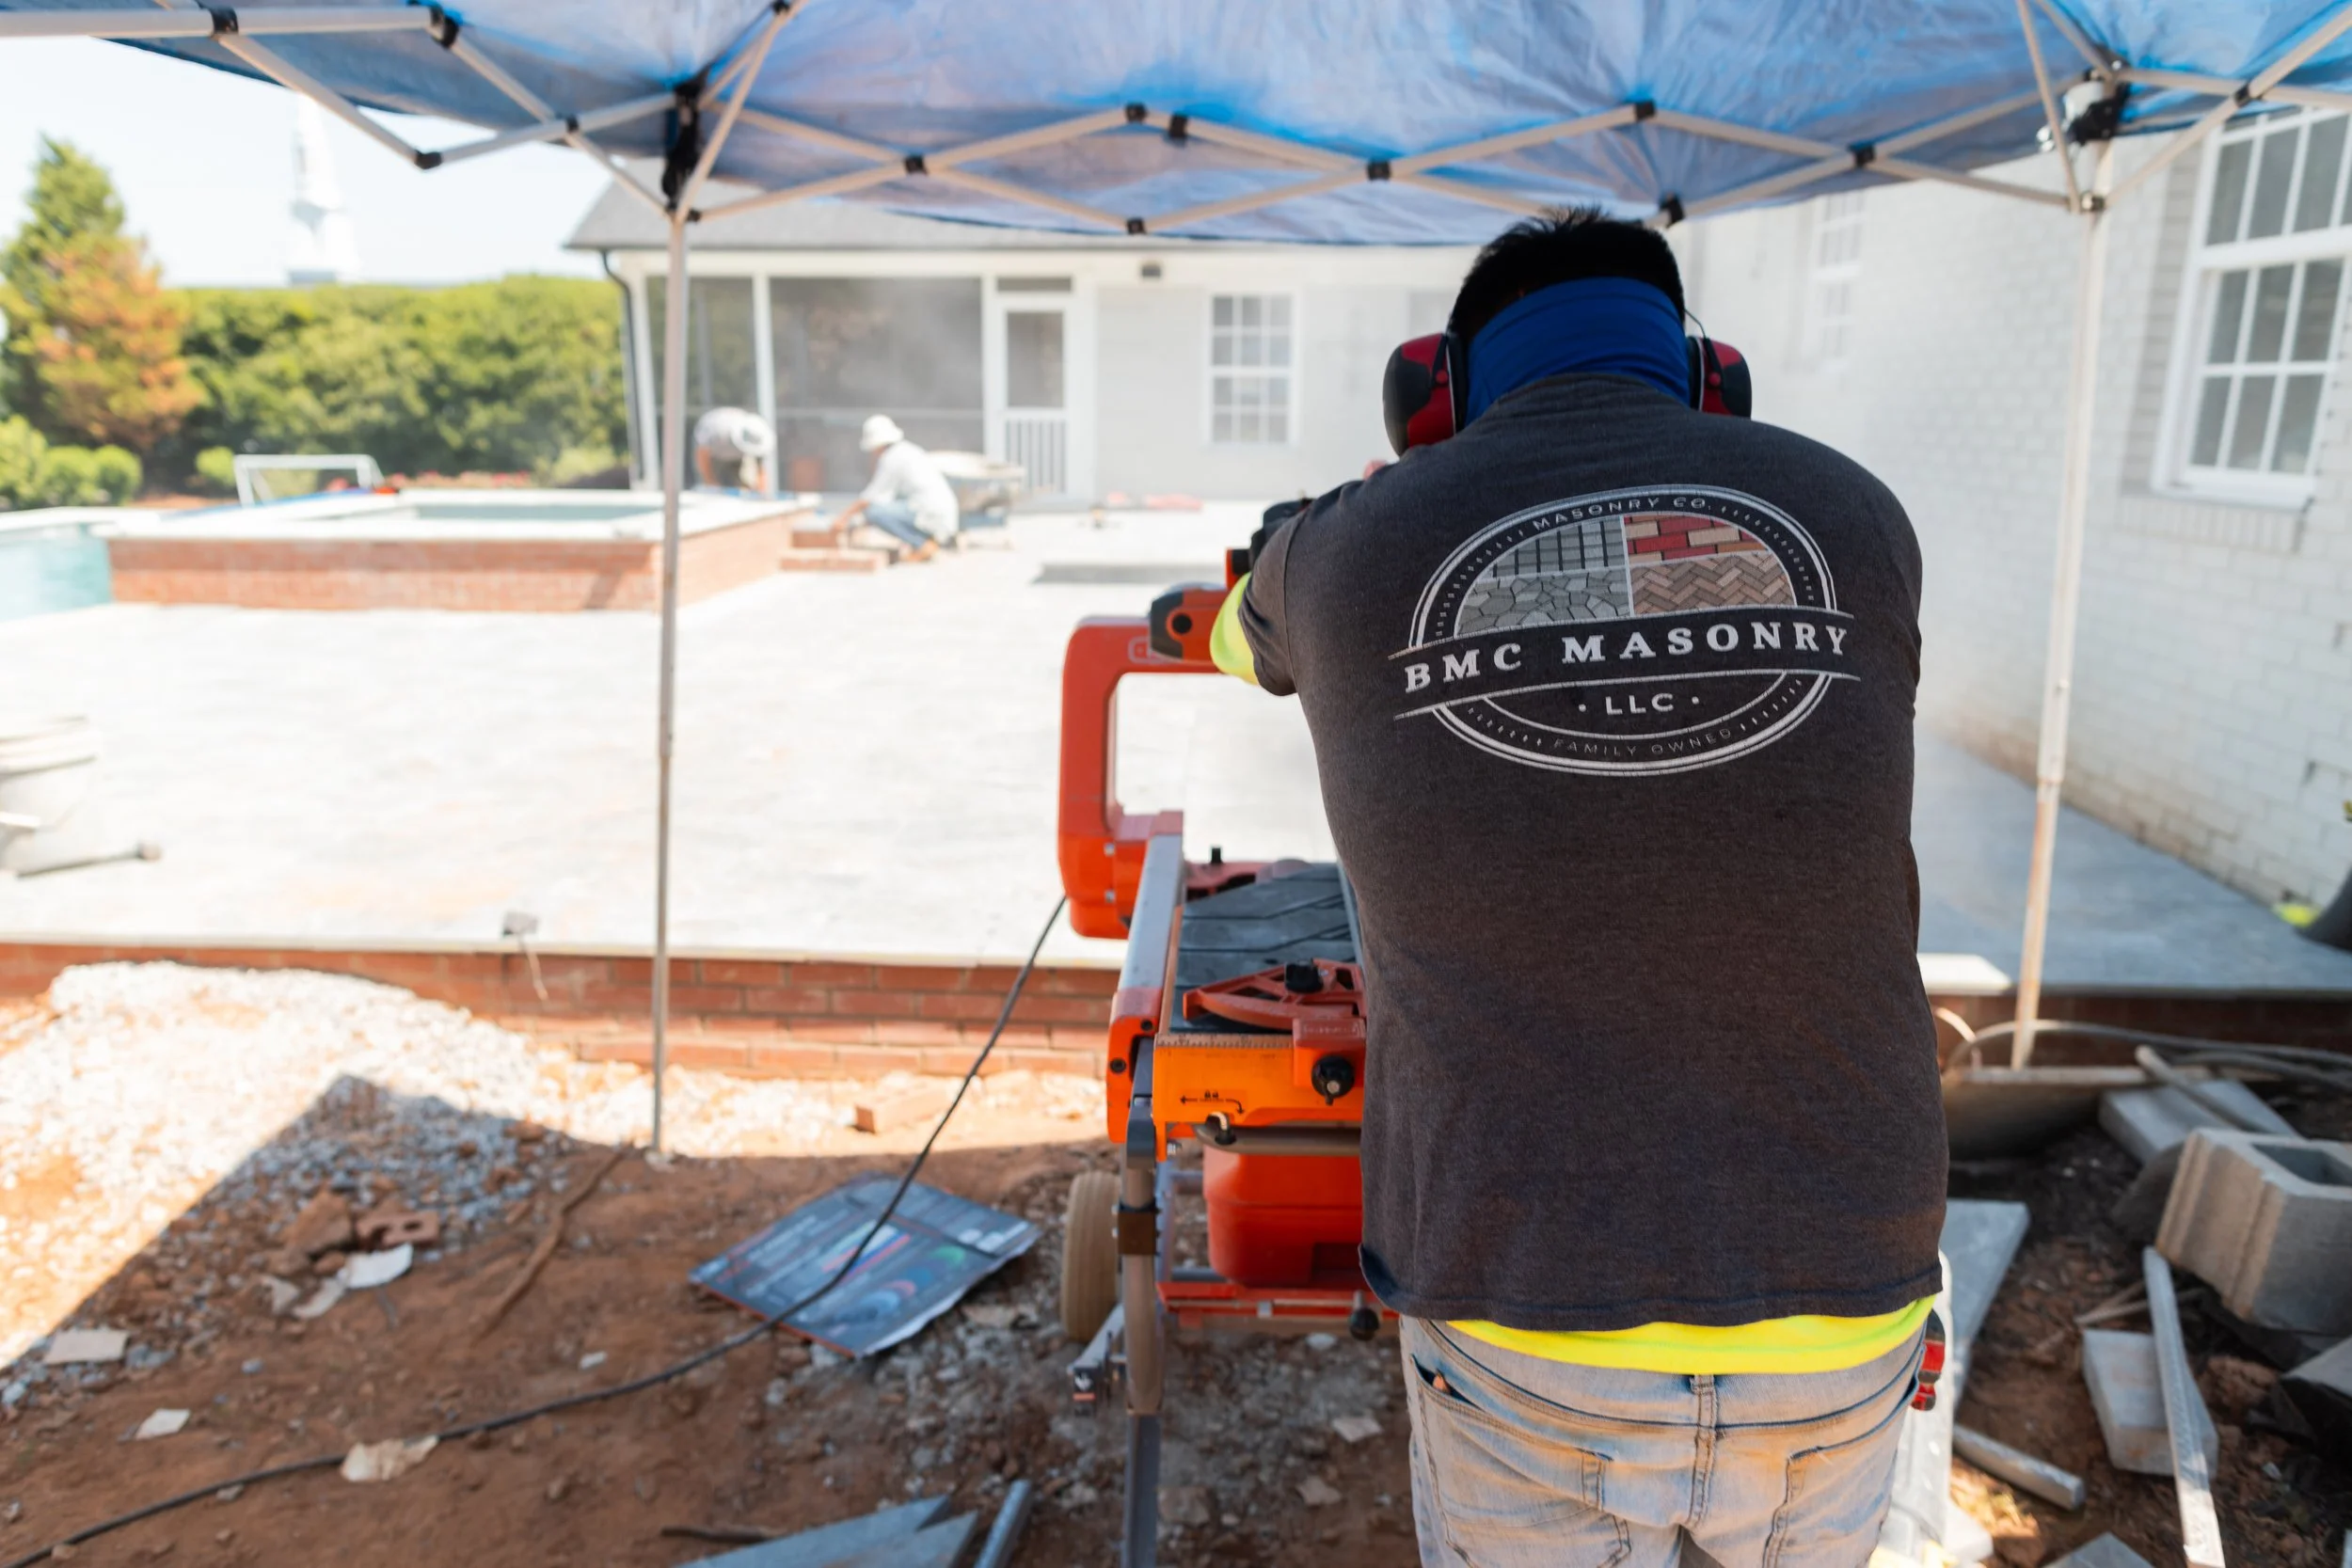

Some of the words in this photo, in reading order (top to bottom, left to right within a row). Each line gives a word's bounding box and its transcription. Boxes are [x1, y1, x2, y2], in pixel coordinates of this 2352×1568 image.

[1533, 497, 1660, 531] MASONRY
[1405, 642, 1522, 693] BMC
[1562, 621, 1847, 663] MASONRY
[1605, 692, 1674, 715] LLC
[1553, 737, 1637, 757] FAMILY
[1651, 729, 1732, 753] OWNED
